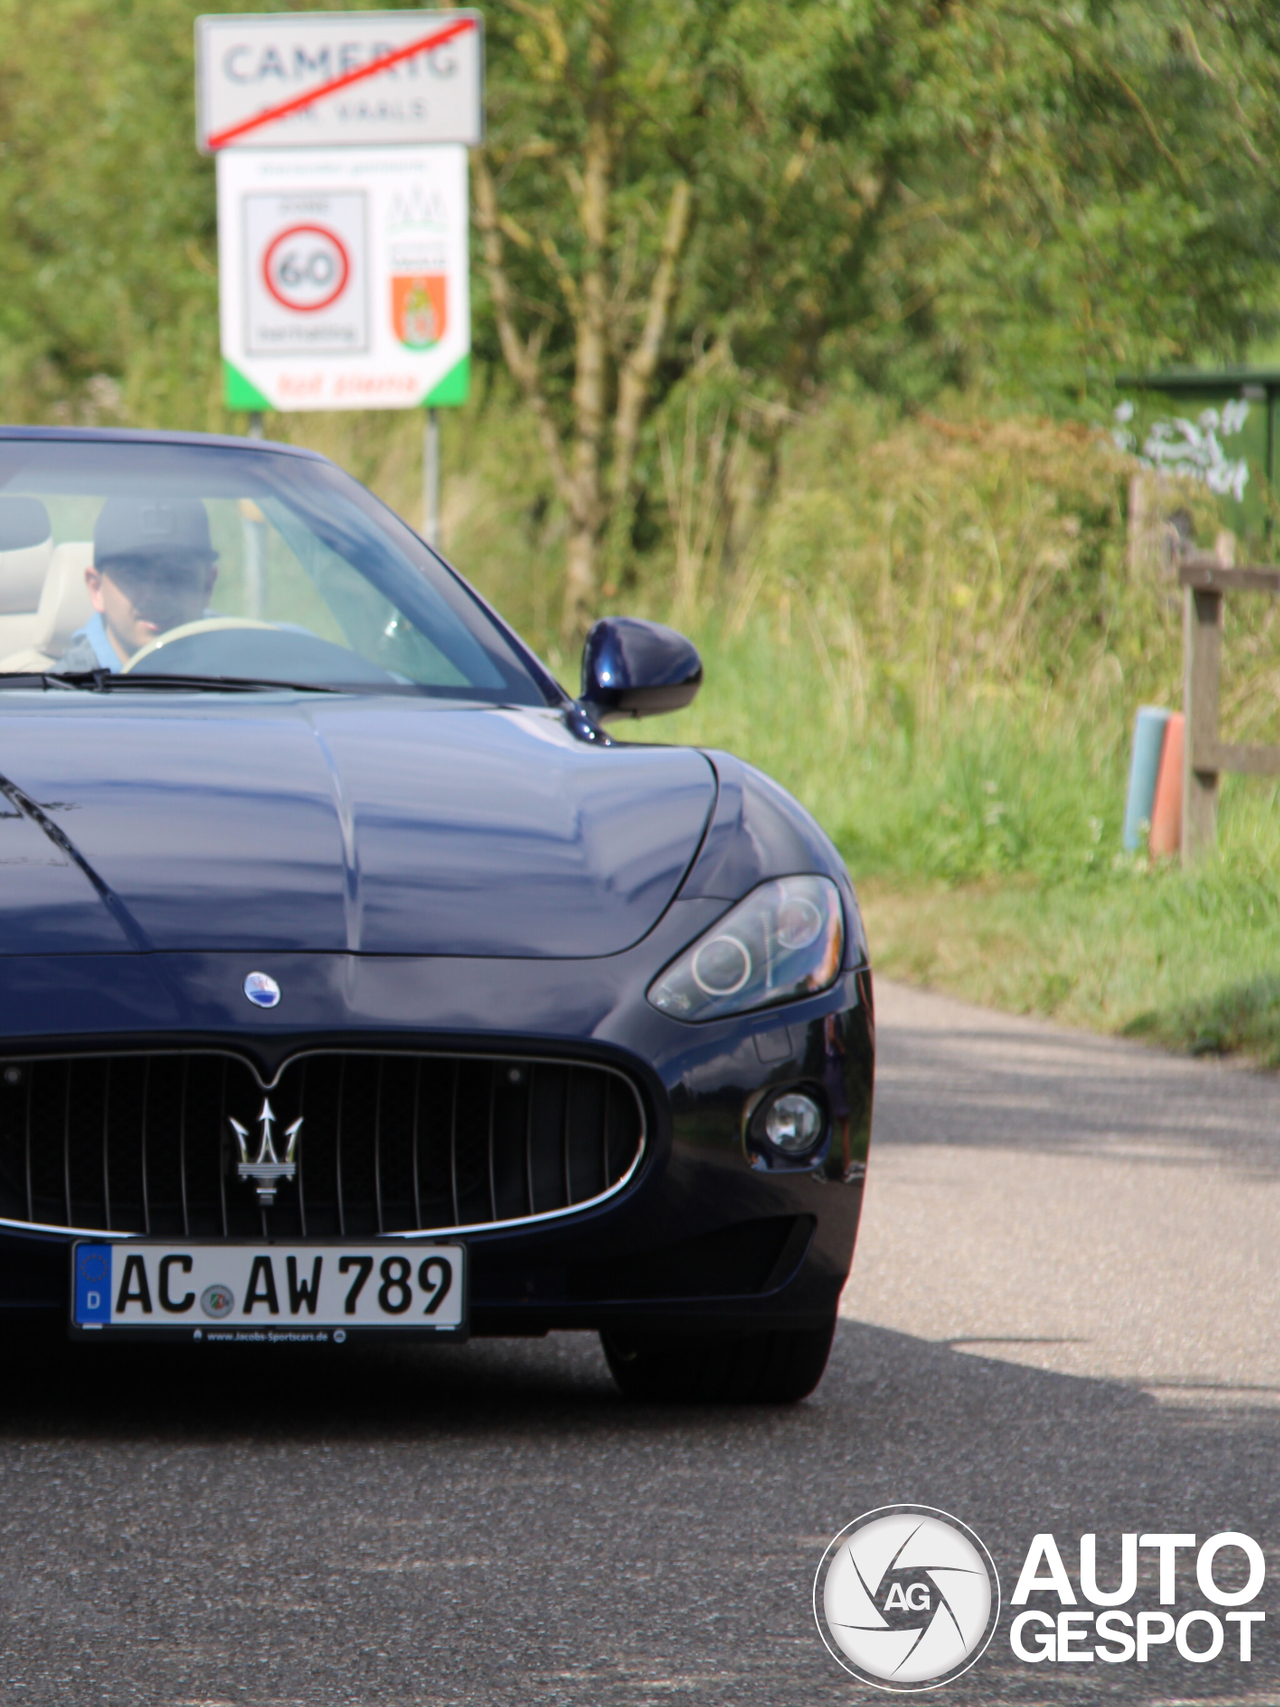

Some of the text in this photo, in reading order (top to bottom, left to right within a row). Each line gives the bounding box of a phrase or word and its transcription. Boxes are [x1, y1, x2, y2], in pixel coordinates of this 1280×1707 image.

[278, 251, 336, 288] 60
[86, 1291, 101, 1310] D
[115, 1254, 453, 1315] AC AW 789
